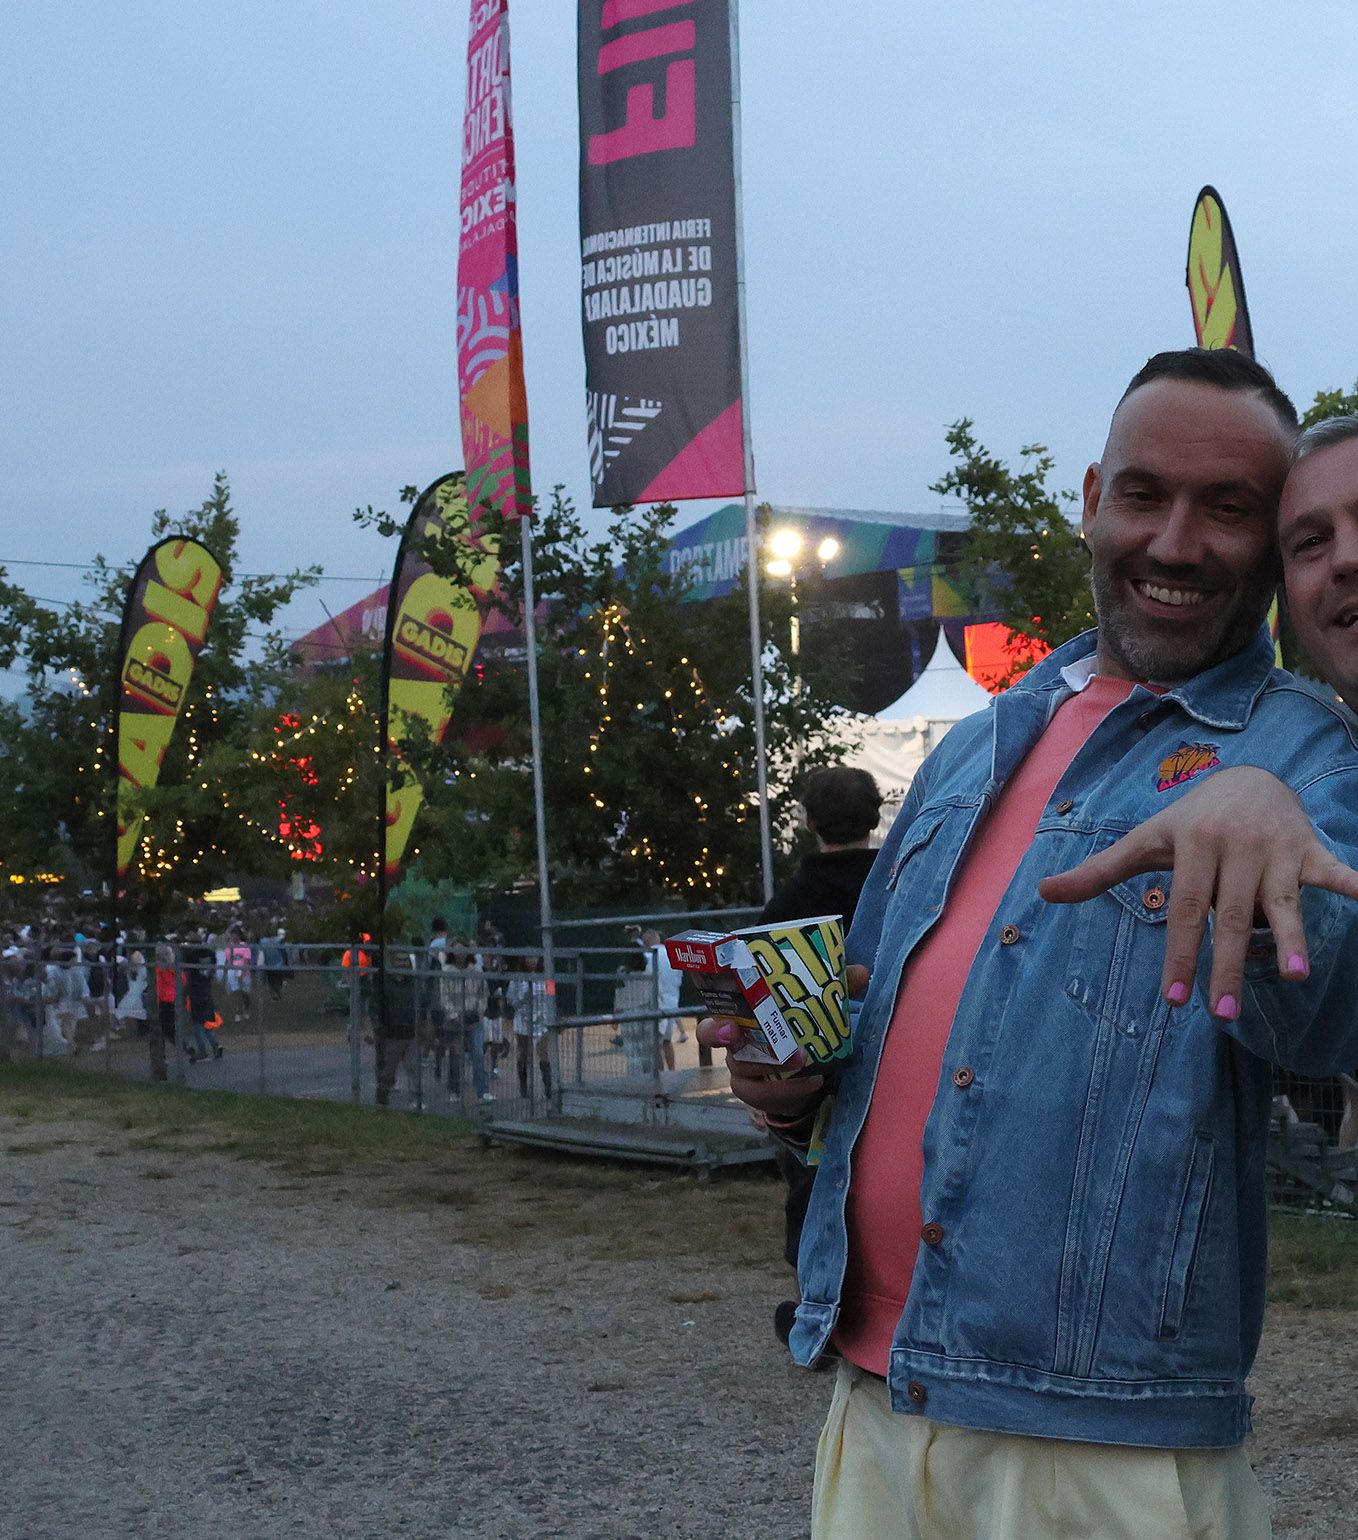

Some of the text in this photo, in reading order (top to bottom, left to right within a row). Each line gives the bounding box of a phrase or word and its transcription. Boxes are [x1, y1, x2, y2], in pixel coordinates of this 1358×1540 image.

[402, 620, 467, 669] GADIS
[129, 662, 181, 705] GADIS
[674, 944, 707, 965] Marlboro
[763, 1020, 780, 1045] mata
[770, 1010, 788, 1040] Fumar
